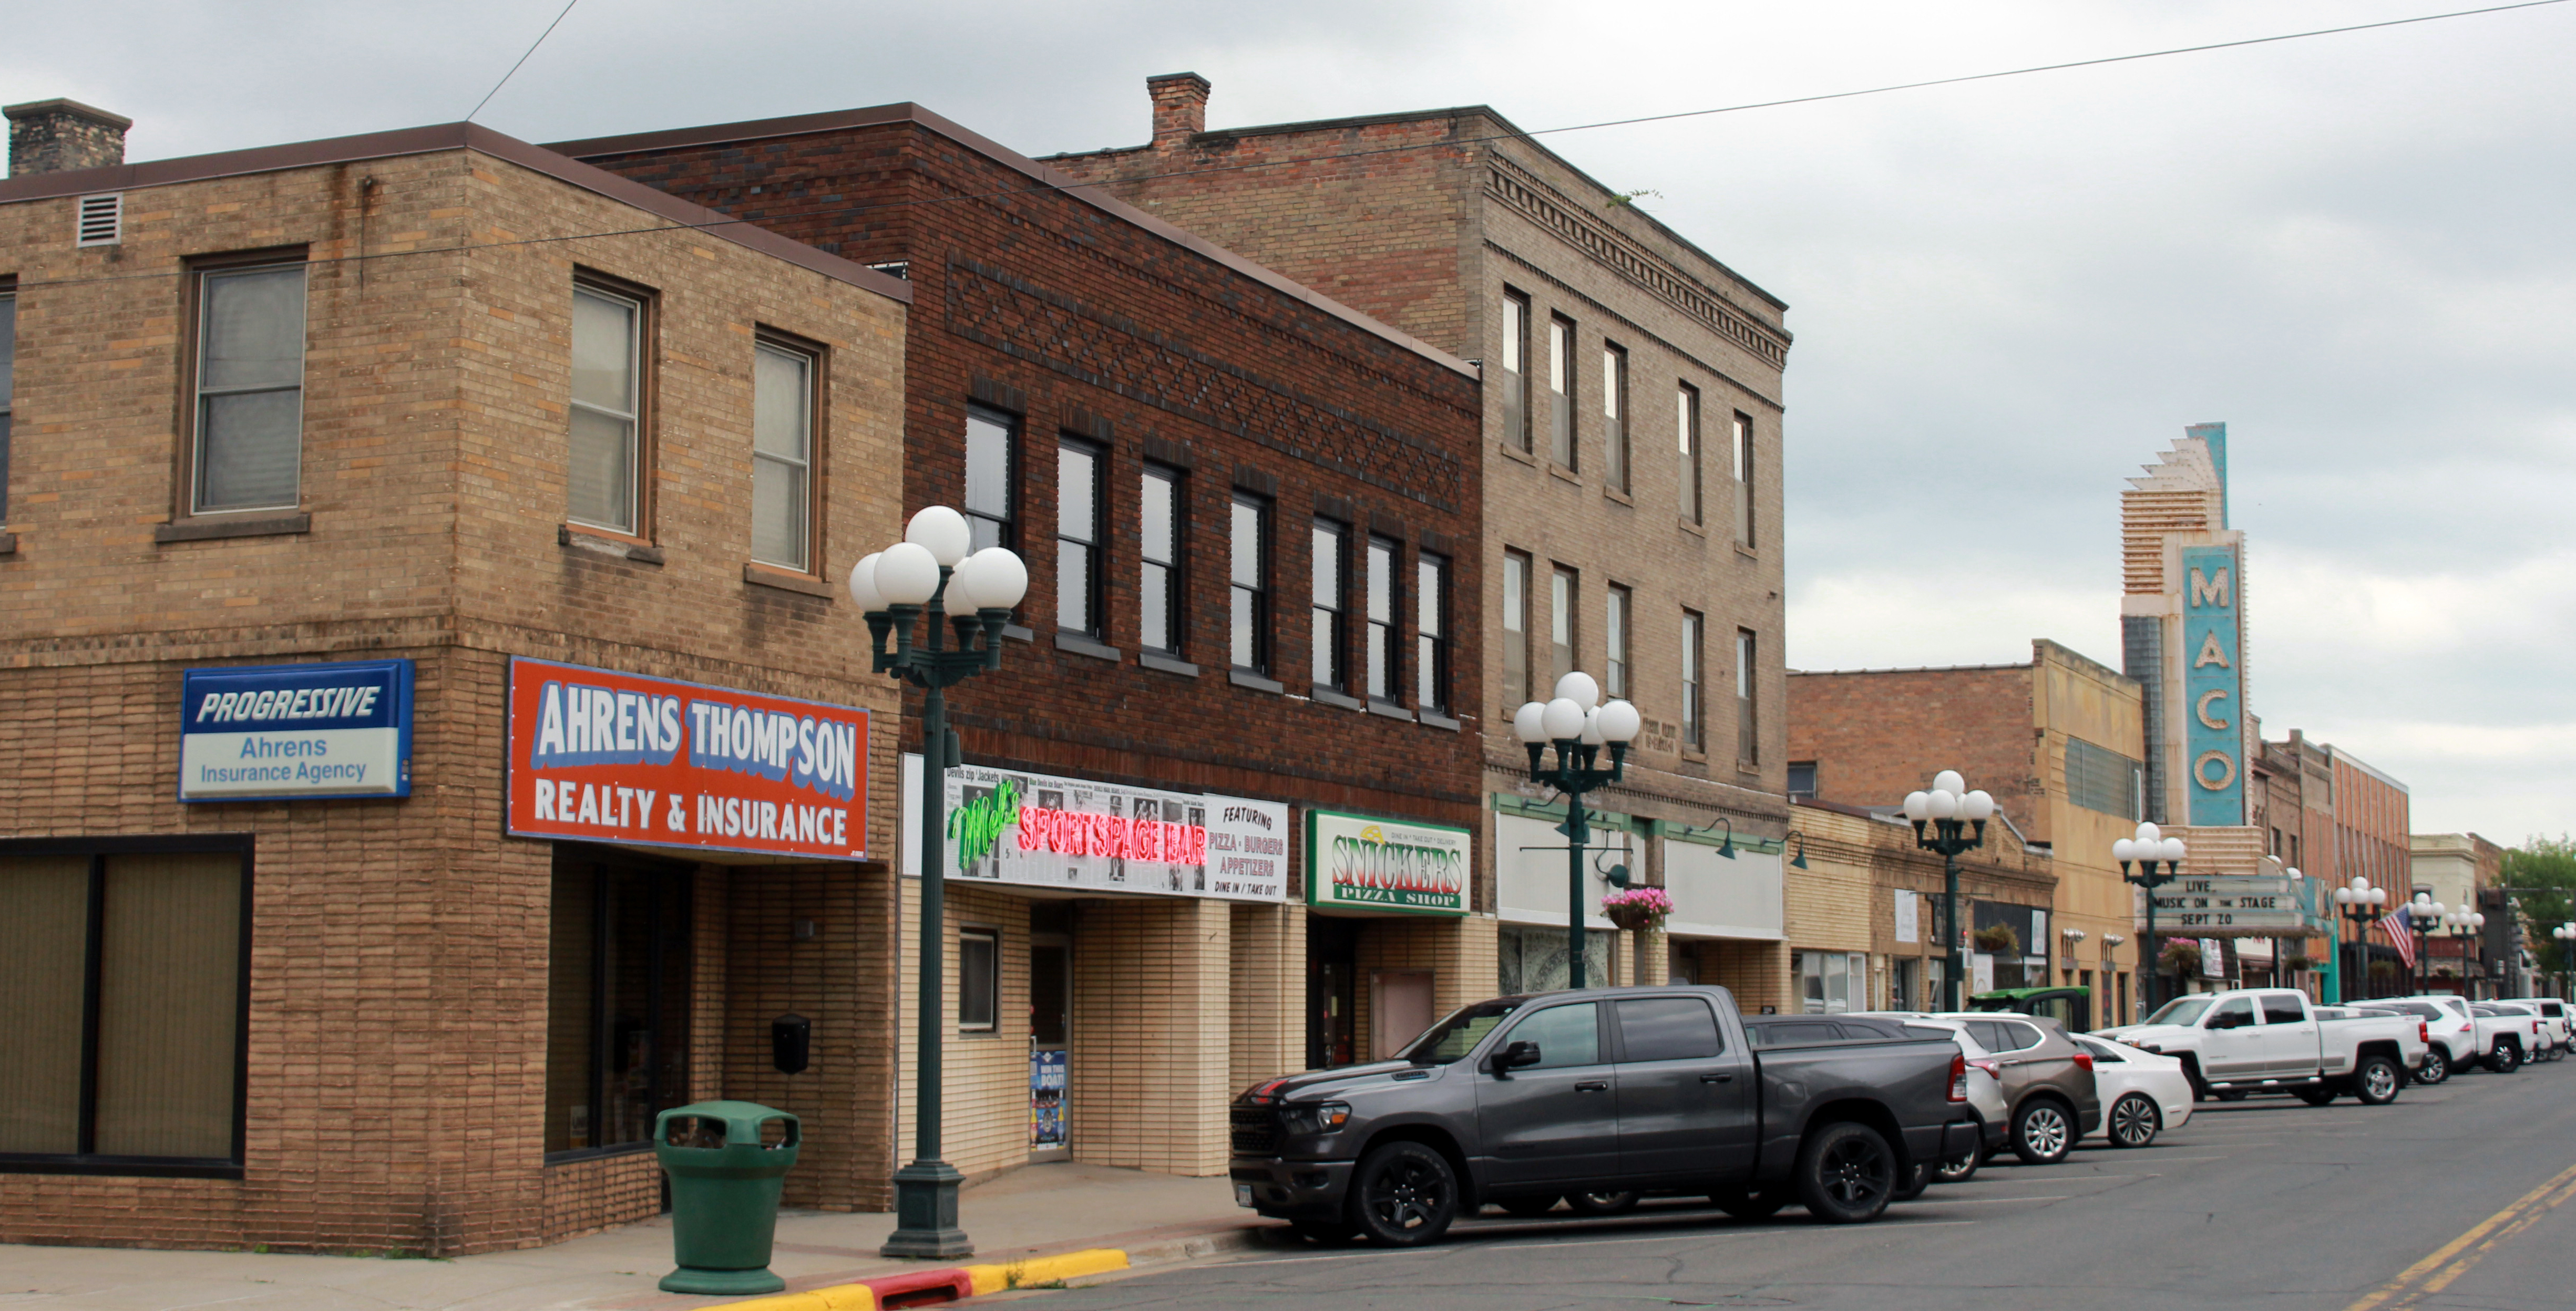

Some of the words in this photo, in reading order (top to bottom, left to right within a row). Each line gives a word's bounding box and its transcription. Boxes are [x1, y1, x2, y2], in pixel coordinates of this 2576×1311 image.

[2190, 566, 2236, 791] MACO
[196, 686, 382, 723] PROGRESSIVE
[240, 736, 327, 759] Ahrens
[538, 684, 680, 756] AHRENS
[691, 701, 856, 789] THOMPSON
[201, 764, 291, 782] Insurance
[296, 761, 366, 783] Agency
[966, 770, 974, 780] zip
[535, 778, 655, 829] REALTY
[667, 794, 686, 831] &
[697, 794, 847, 845] INSURANCE
[1223, 806, 1272, 831] FEATURING
[948, 780, 1020, 869] Mel's
[1165, 824, 1208, 865] BAR
[1209, 832, 1237, 851] PIZZA
[1244, 835, 1283, 855] BURGERS
[1219, 856, 1274, 876] APPETIZERS
[1332, 834, 1462, 894] SNICKERS
[1215, 881, 1231, 892] DINE
[1232, 882, 1239, 893] IN
[1248, 883, 1263, 895] TAKE
[1265, 885, 1277, 896] OUT
[1341, 887, 1396, 902] PIZZA
[1406, 893, 1455, 906] SHOP
[2185, 880, 2210, 893] LIVE
[2154, 897, 2186, 909] MUSIC
[2194, 897, 2208, 908] ON
[2240, 897, 2275, 908] STAGE
[2181, 914, 2209, 925] SEPT
[1041, 1065, 1052, 1073] WIN
[1052, 1064, 1064, 1073] THIS
[1041, 1073, 1064, 1086] BOAT!
